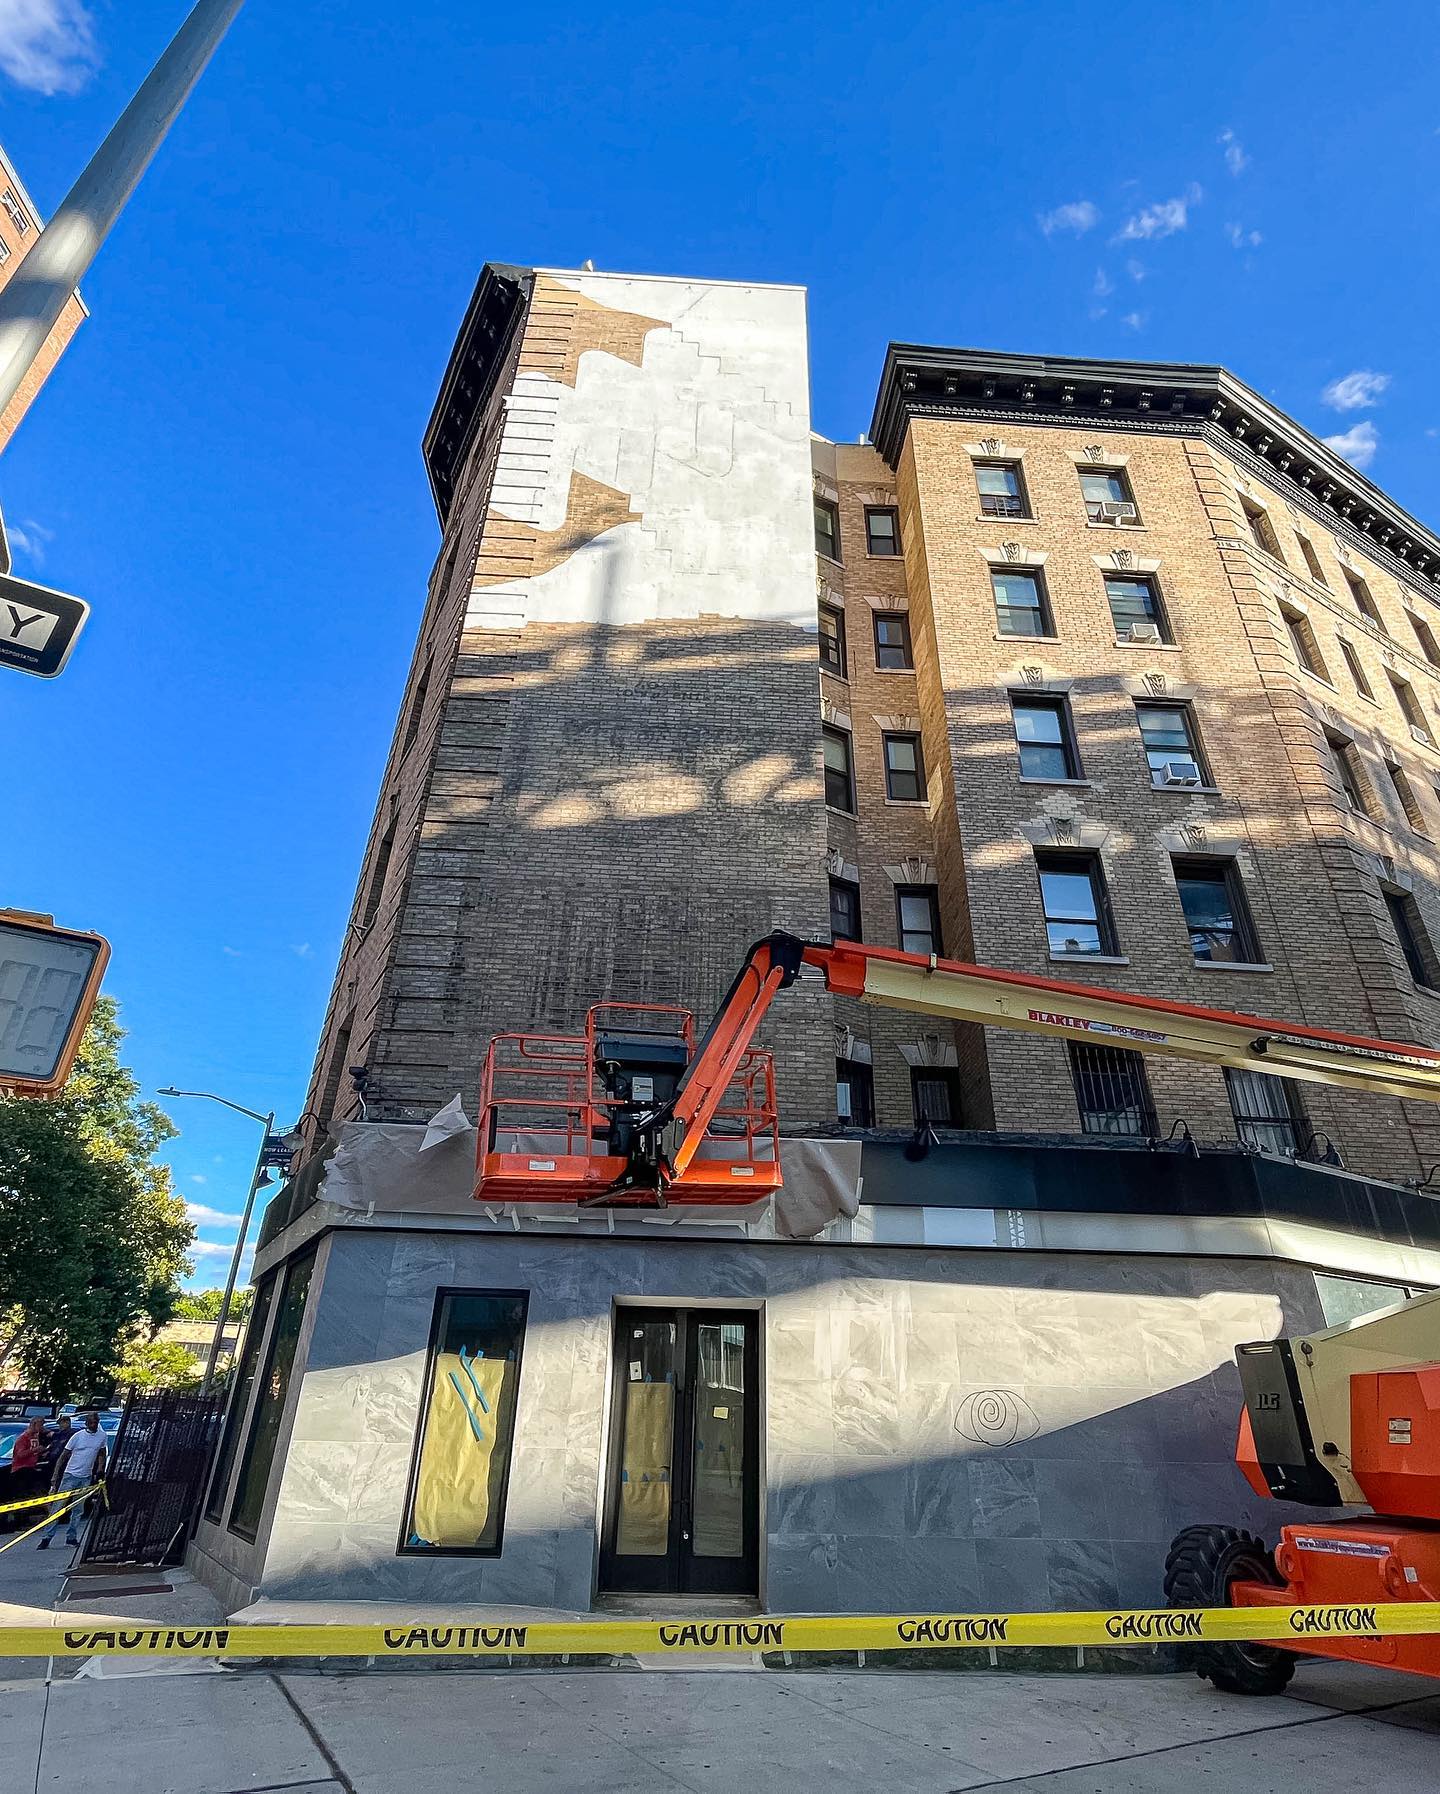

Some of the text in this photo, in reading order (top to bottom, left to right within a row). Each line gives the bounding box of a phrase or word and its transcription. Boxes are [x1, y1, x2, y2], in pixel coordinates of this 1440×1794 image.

[1028, 1010, 1090, 1030] BLAKLEY
[64, 1608, 1378, 1649] CAUTION CAUTION CAUTION CAUTION CAUTION CAUTION
